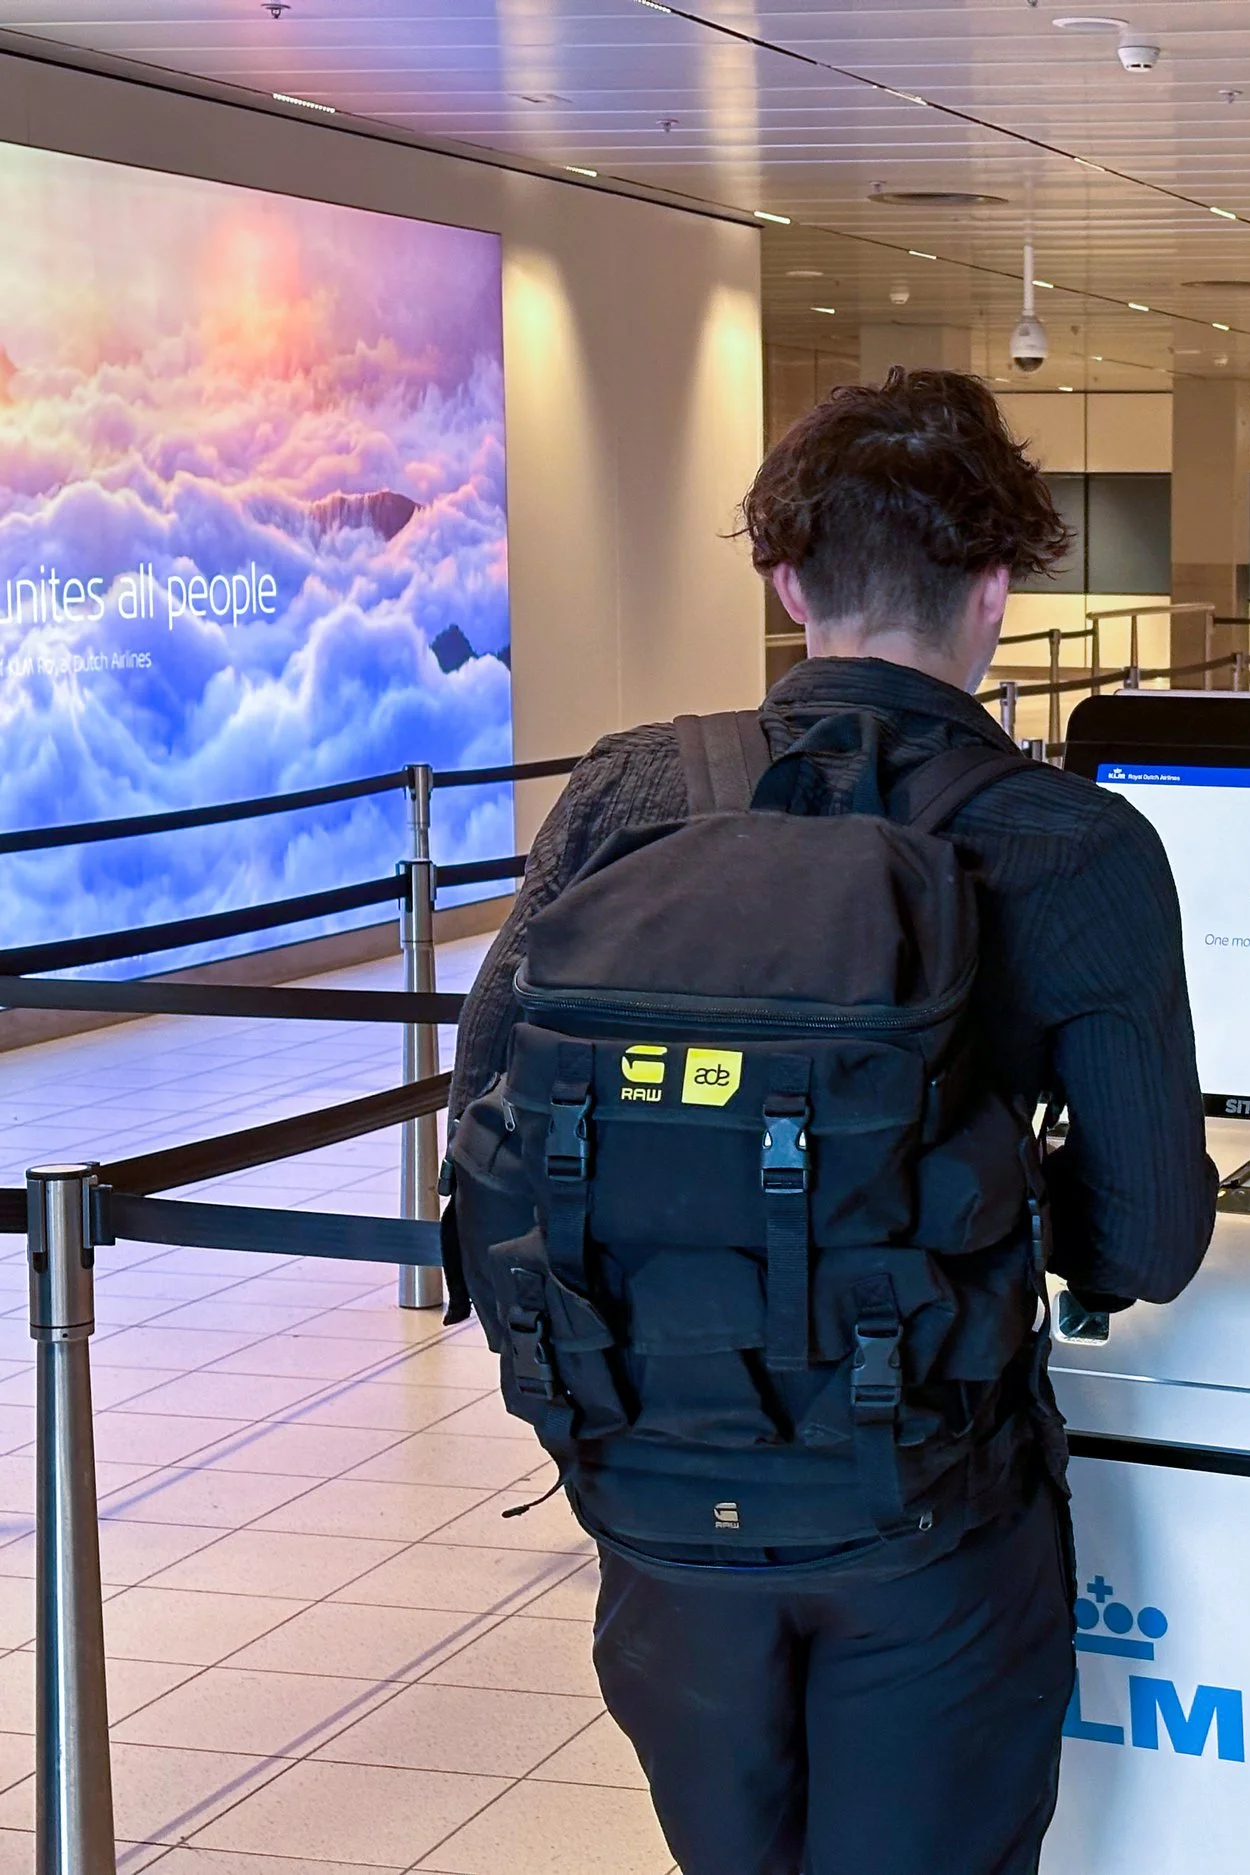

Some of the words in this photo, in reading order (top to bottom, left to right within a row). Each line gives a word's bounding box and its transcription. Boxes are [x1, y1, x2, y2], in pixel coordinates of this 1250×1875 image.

[117, 562, 155, 619] all
[167, 561, 277, 631] people
[74, 651, 108, 673] Dutch
[111, 650, 152, 669] Airlines
[1128, 774, 1143, 782] Royal
[1204, 933, 1229, 947] One
[620, 1087, 662, 1102] RAW
[1061, 1667, 1246, 1763] LM
